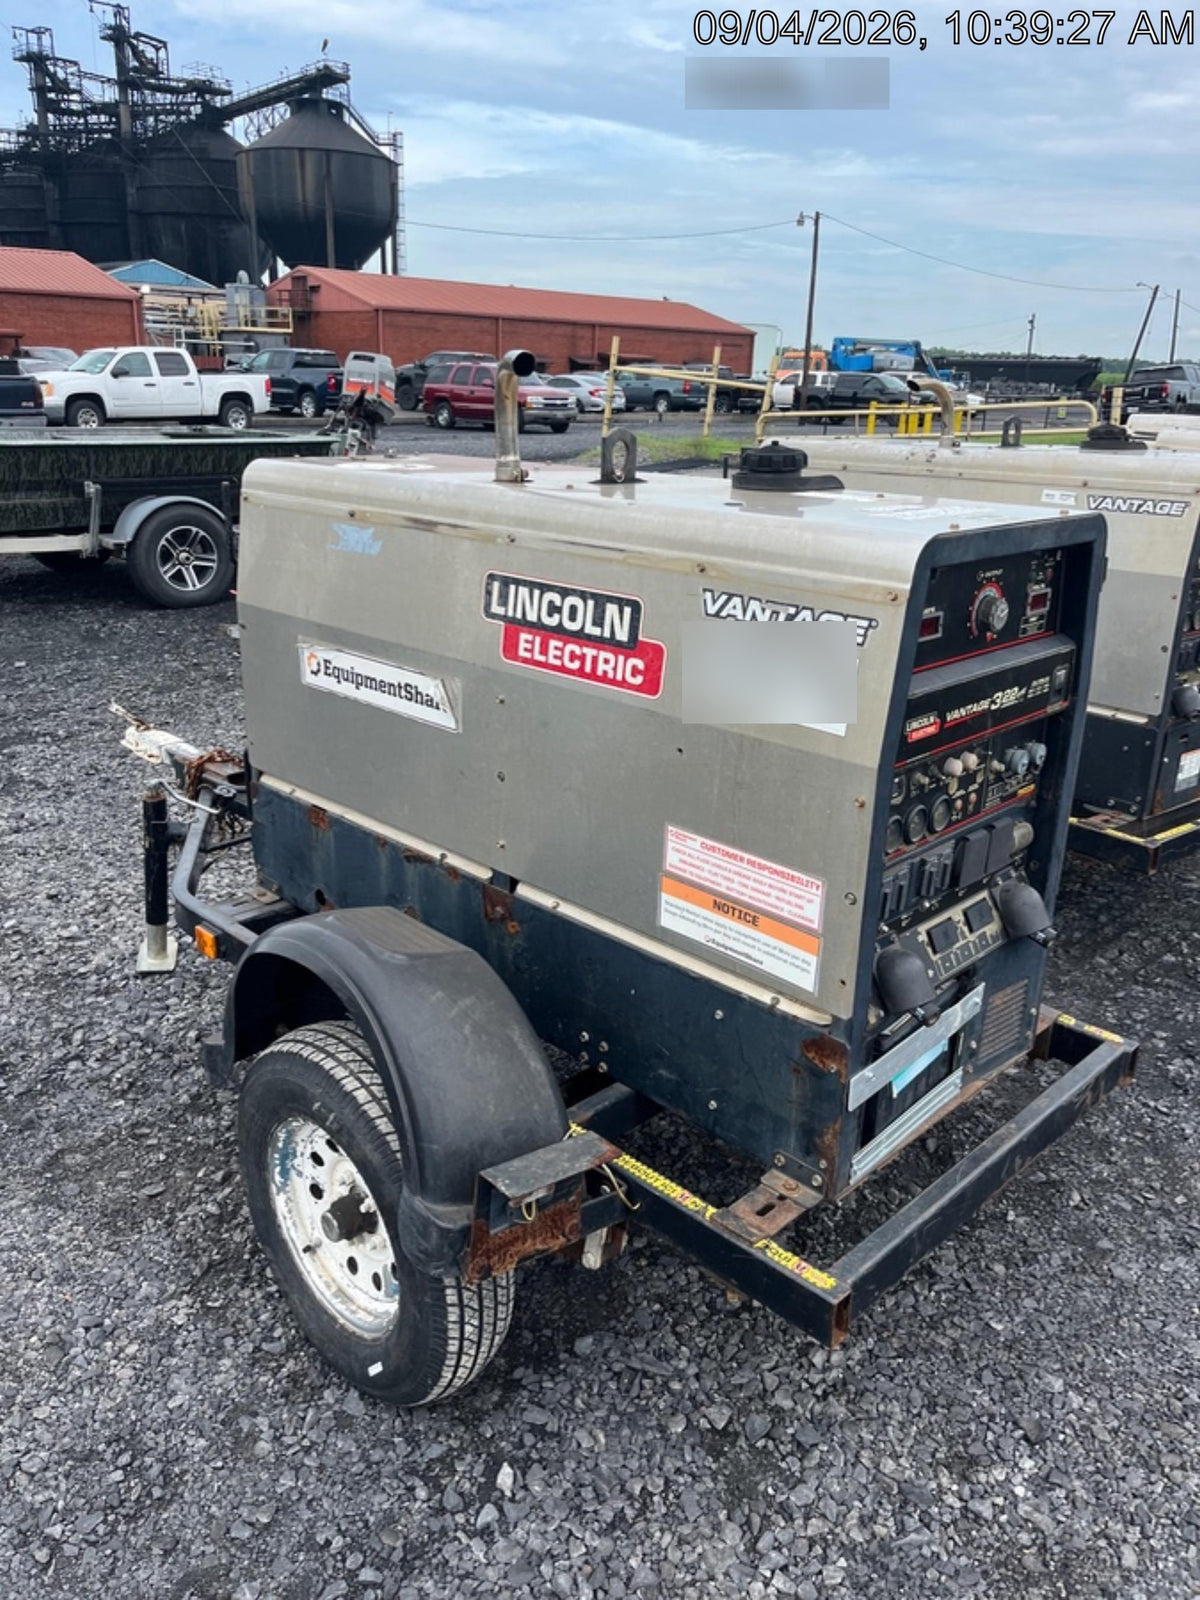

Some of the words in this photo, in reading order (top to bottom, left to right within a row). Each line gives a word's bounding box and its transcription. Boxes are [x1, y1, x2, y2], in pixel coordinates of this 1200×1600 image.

[1087, 494, 1190, 517] VANTAGE
[490, 580, 632, 643] LINCOLN
[517, 632, 645, 686] ELECTRIC
[713, 899, 760, 927] NOTICE
